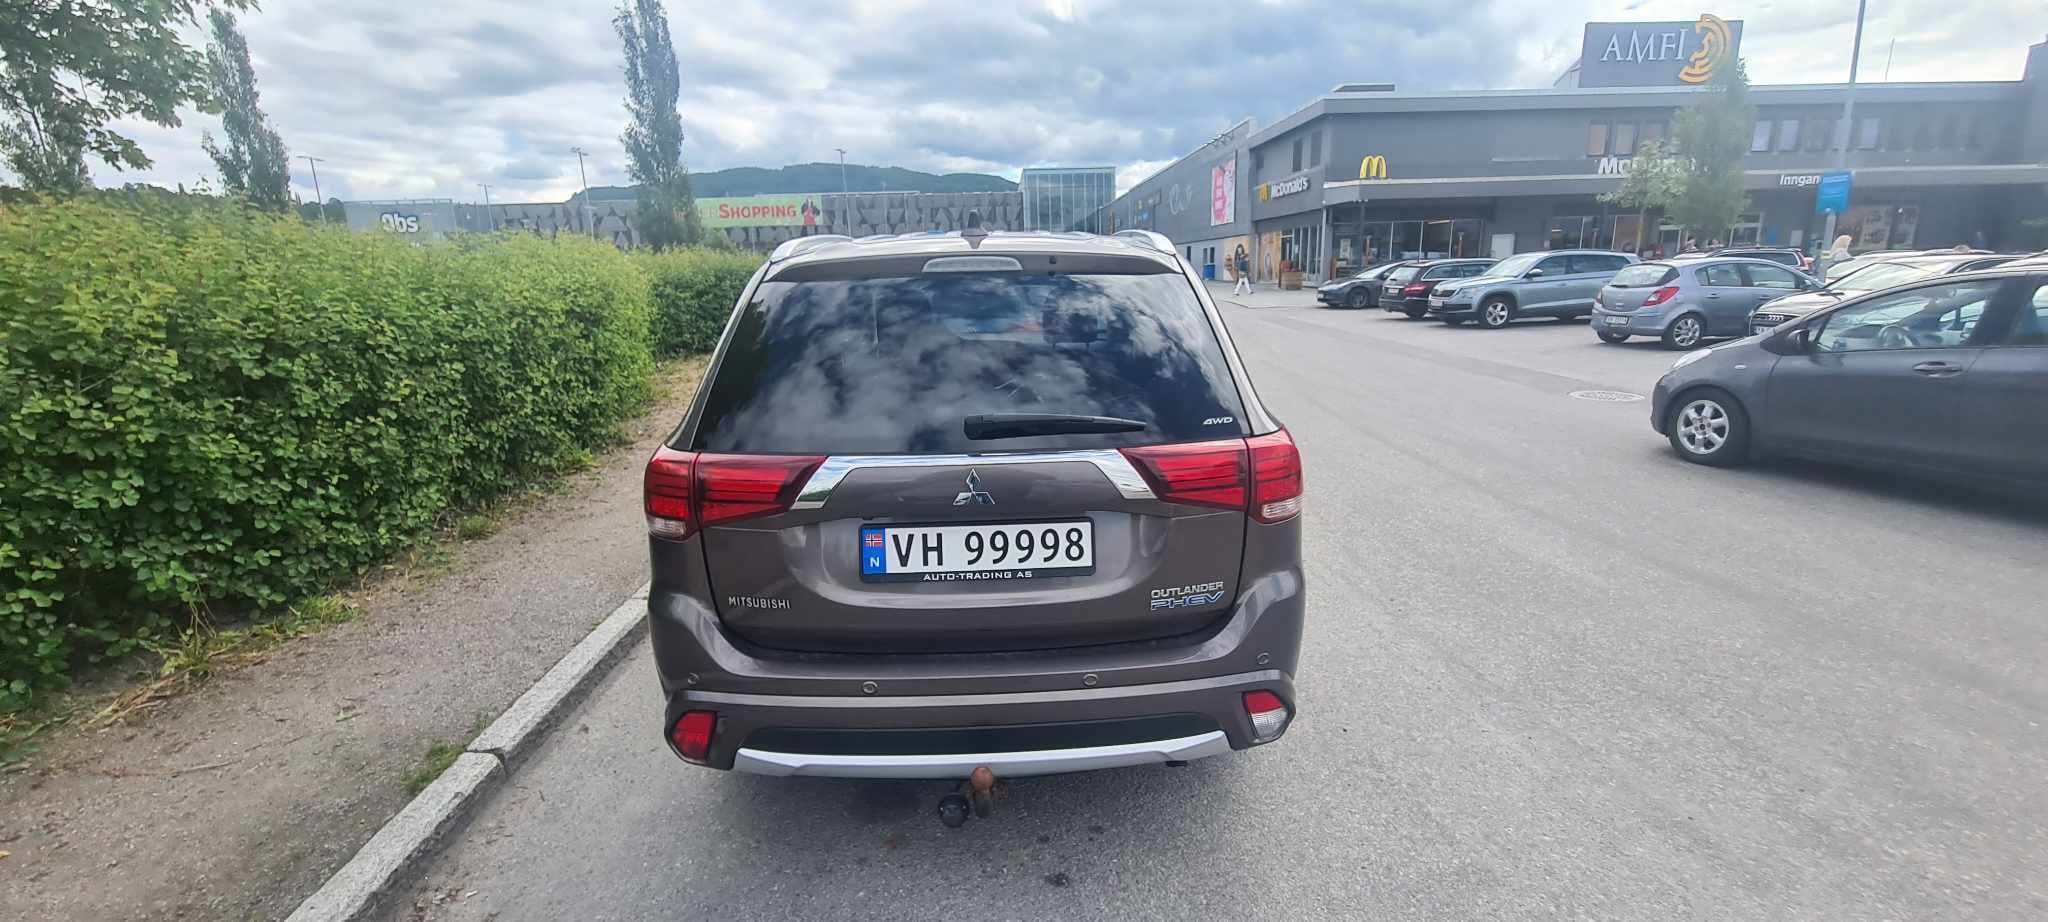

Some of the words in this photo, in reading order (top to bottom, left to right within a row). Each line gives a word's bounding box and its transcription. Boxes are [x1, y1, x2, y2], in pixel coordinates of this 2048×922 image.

[1600, 28, 1689, 64] AMFI
[1271, 176, 1310, 200] McDonald's
[869, 556, 880, 568] N
[891, 531, 944, 568] VH
[964, 527, 1085, 566] 99998
[922, 571, 1013, 582] AUTO-TRADING
[1016, 570, 1033, 579] AS
[1150, 581, 1224, 598] OUTLANDER
[728, 596, 791, 609] MITSUBISHI
[1150, 591, 1225, 611] PHEV
